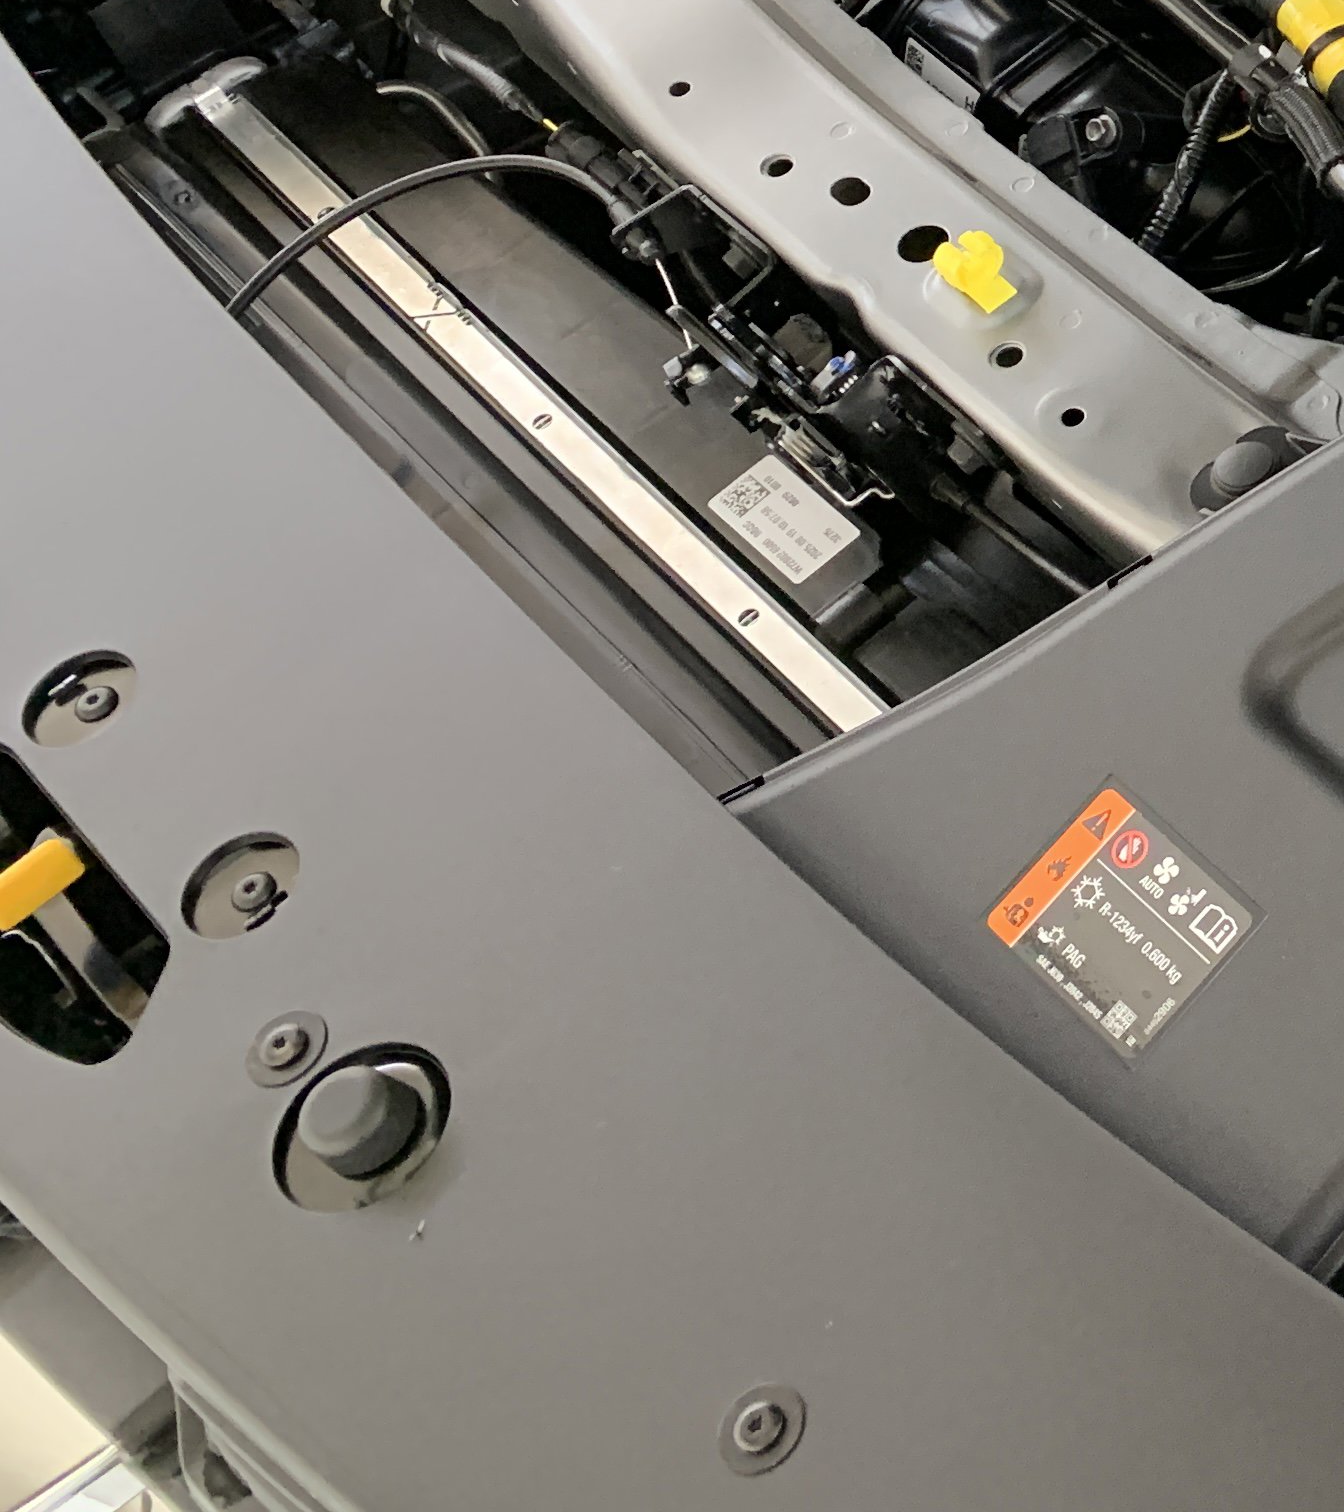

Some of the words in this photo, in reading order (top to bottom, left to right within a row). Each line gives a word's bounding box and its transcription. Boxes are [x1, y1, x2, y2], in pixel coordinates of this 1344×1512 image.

[1138, 875, 1164, 900] AUTO
[1061, 943, 1087, 969] PAG
[1098, 902, 1144, 946] R-1234yf
[1140, 940, 1170, 973] 0.600
[1165, 962, 1182, 986] kg
